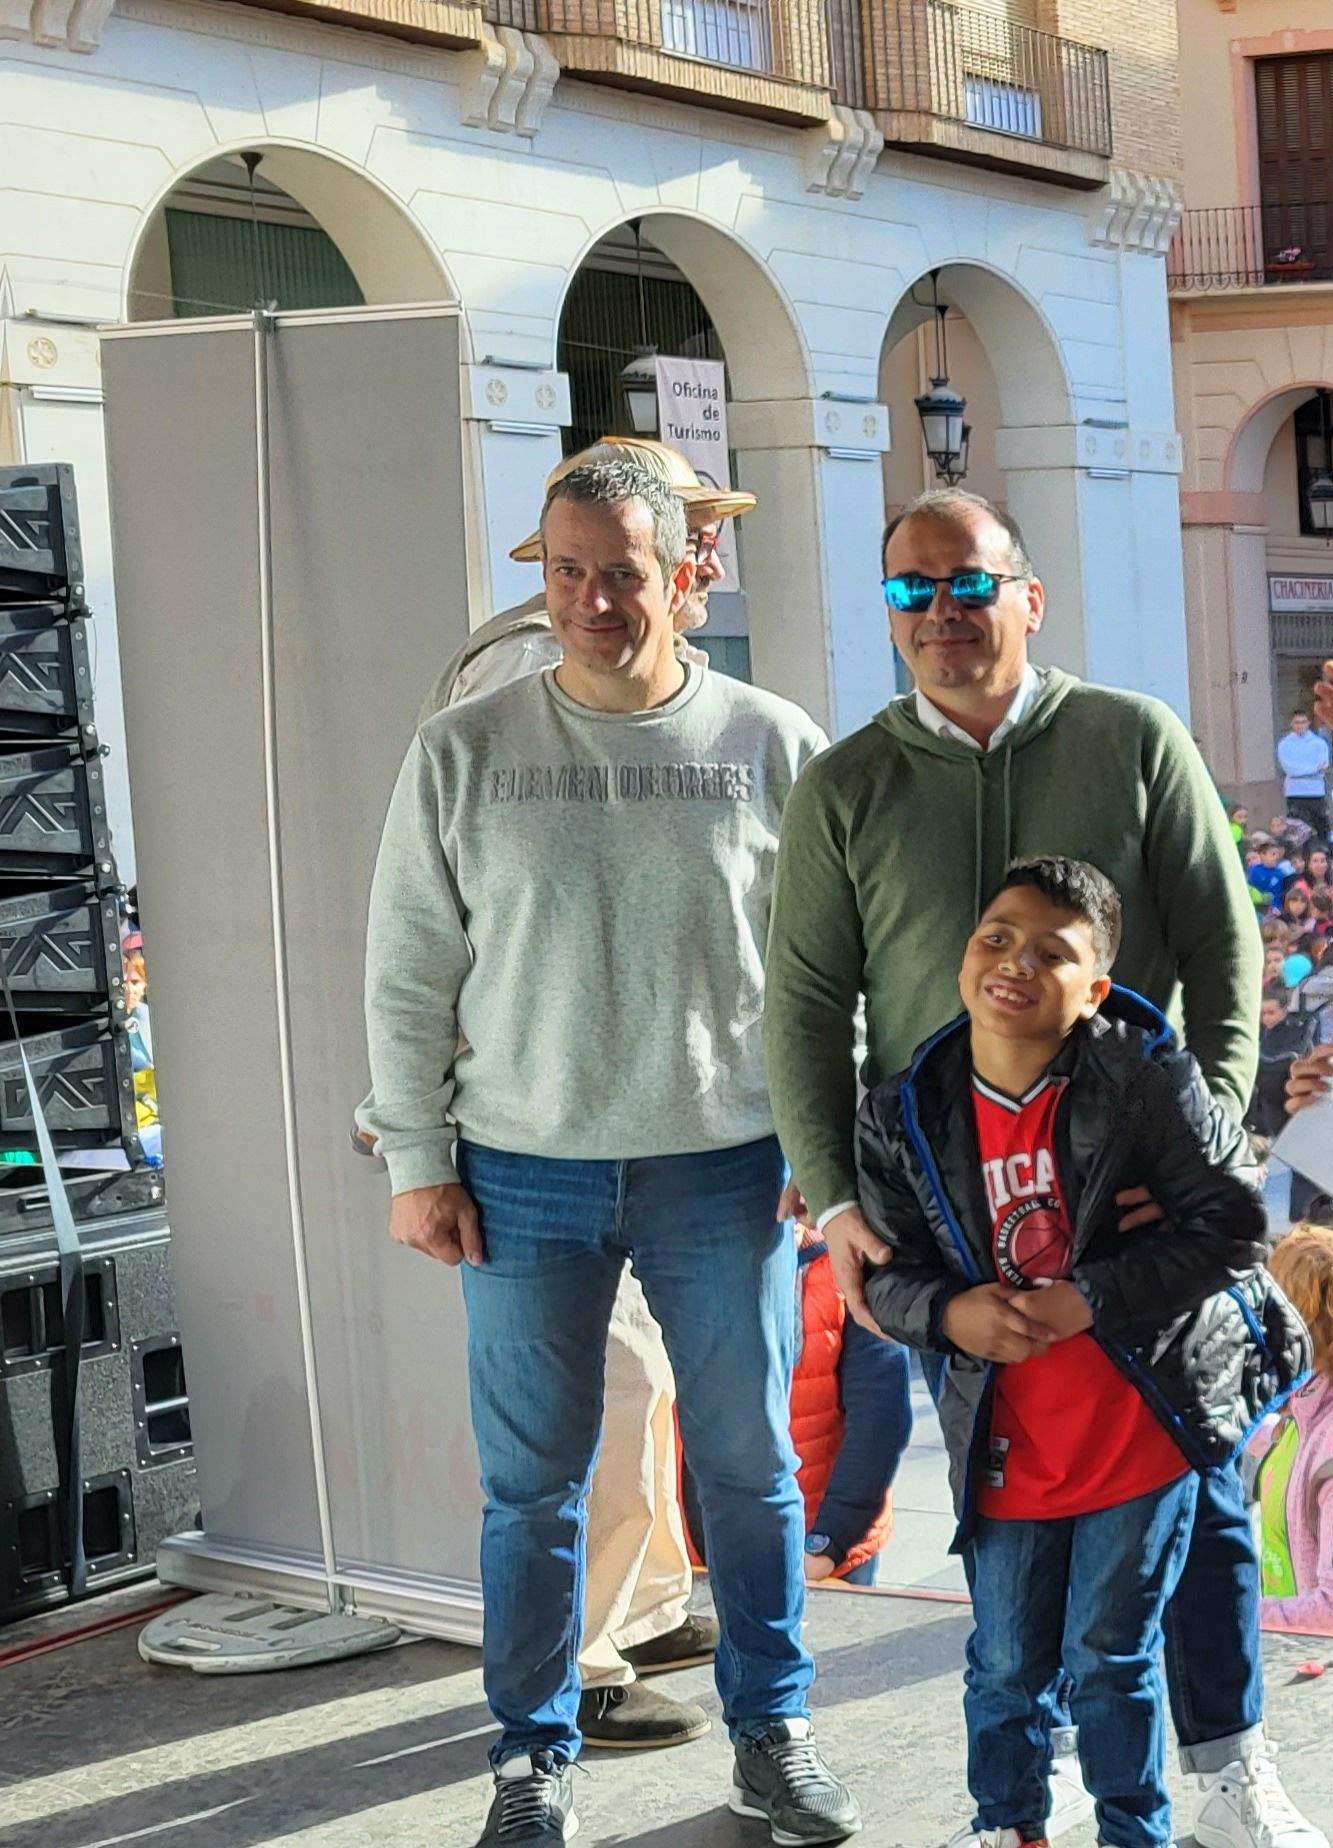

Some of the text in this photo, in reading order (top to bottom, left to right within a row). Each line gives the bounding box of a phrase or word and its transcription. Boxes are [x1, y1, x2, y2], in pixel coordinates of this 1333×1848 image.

[672, 381, 719, 400] Oficina
[702, 404, 720, 421] de
[667, 423, 721, 441] Turismo
